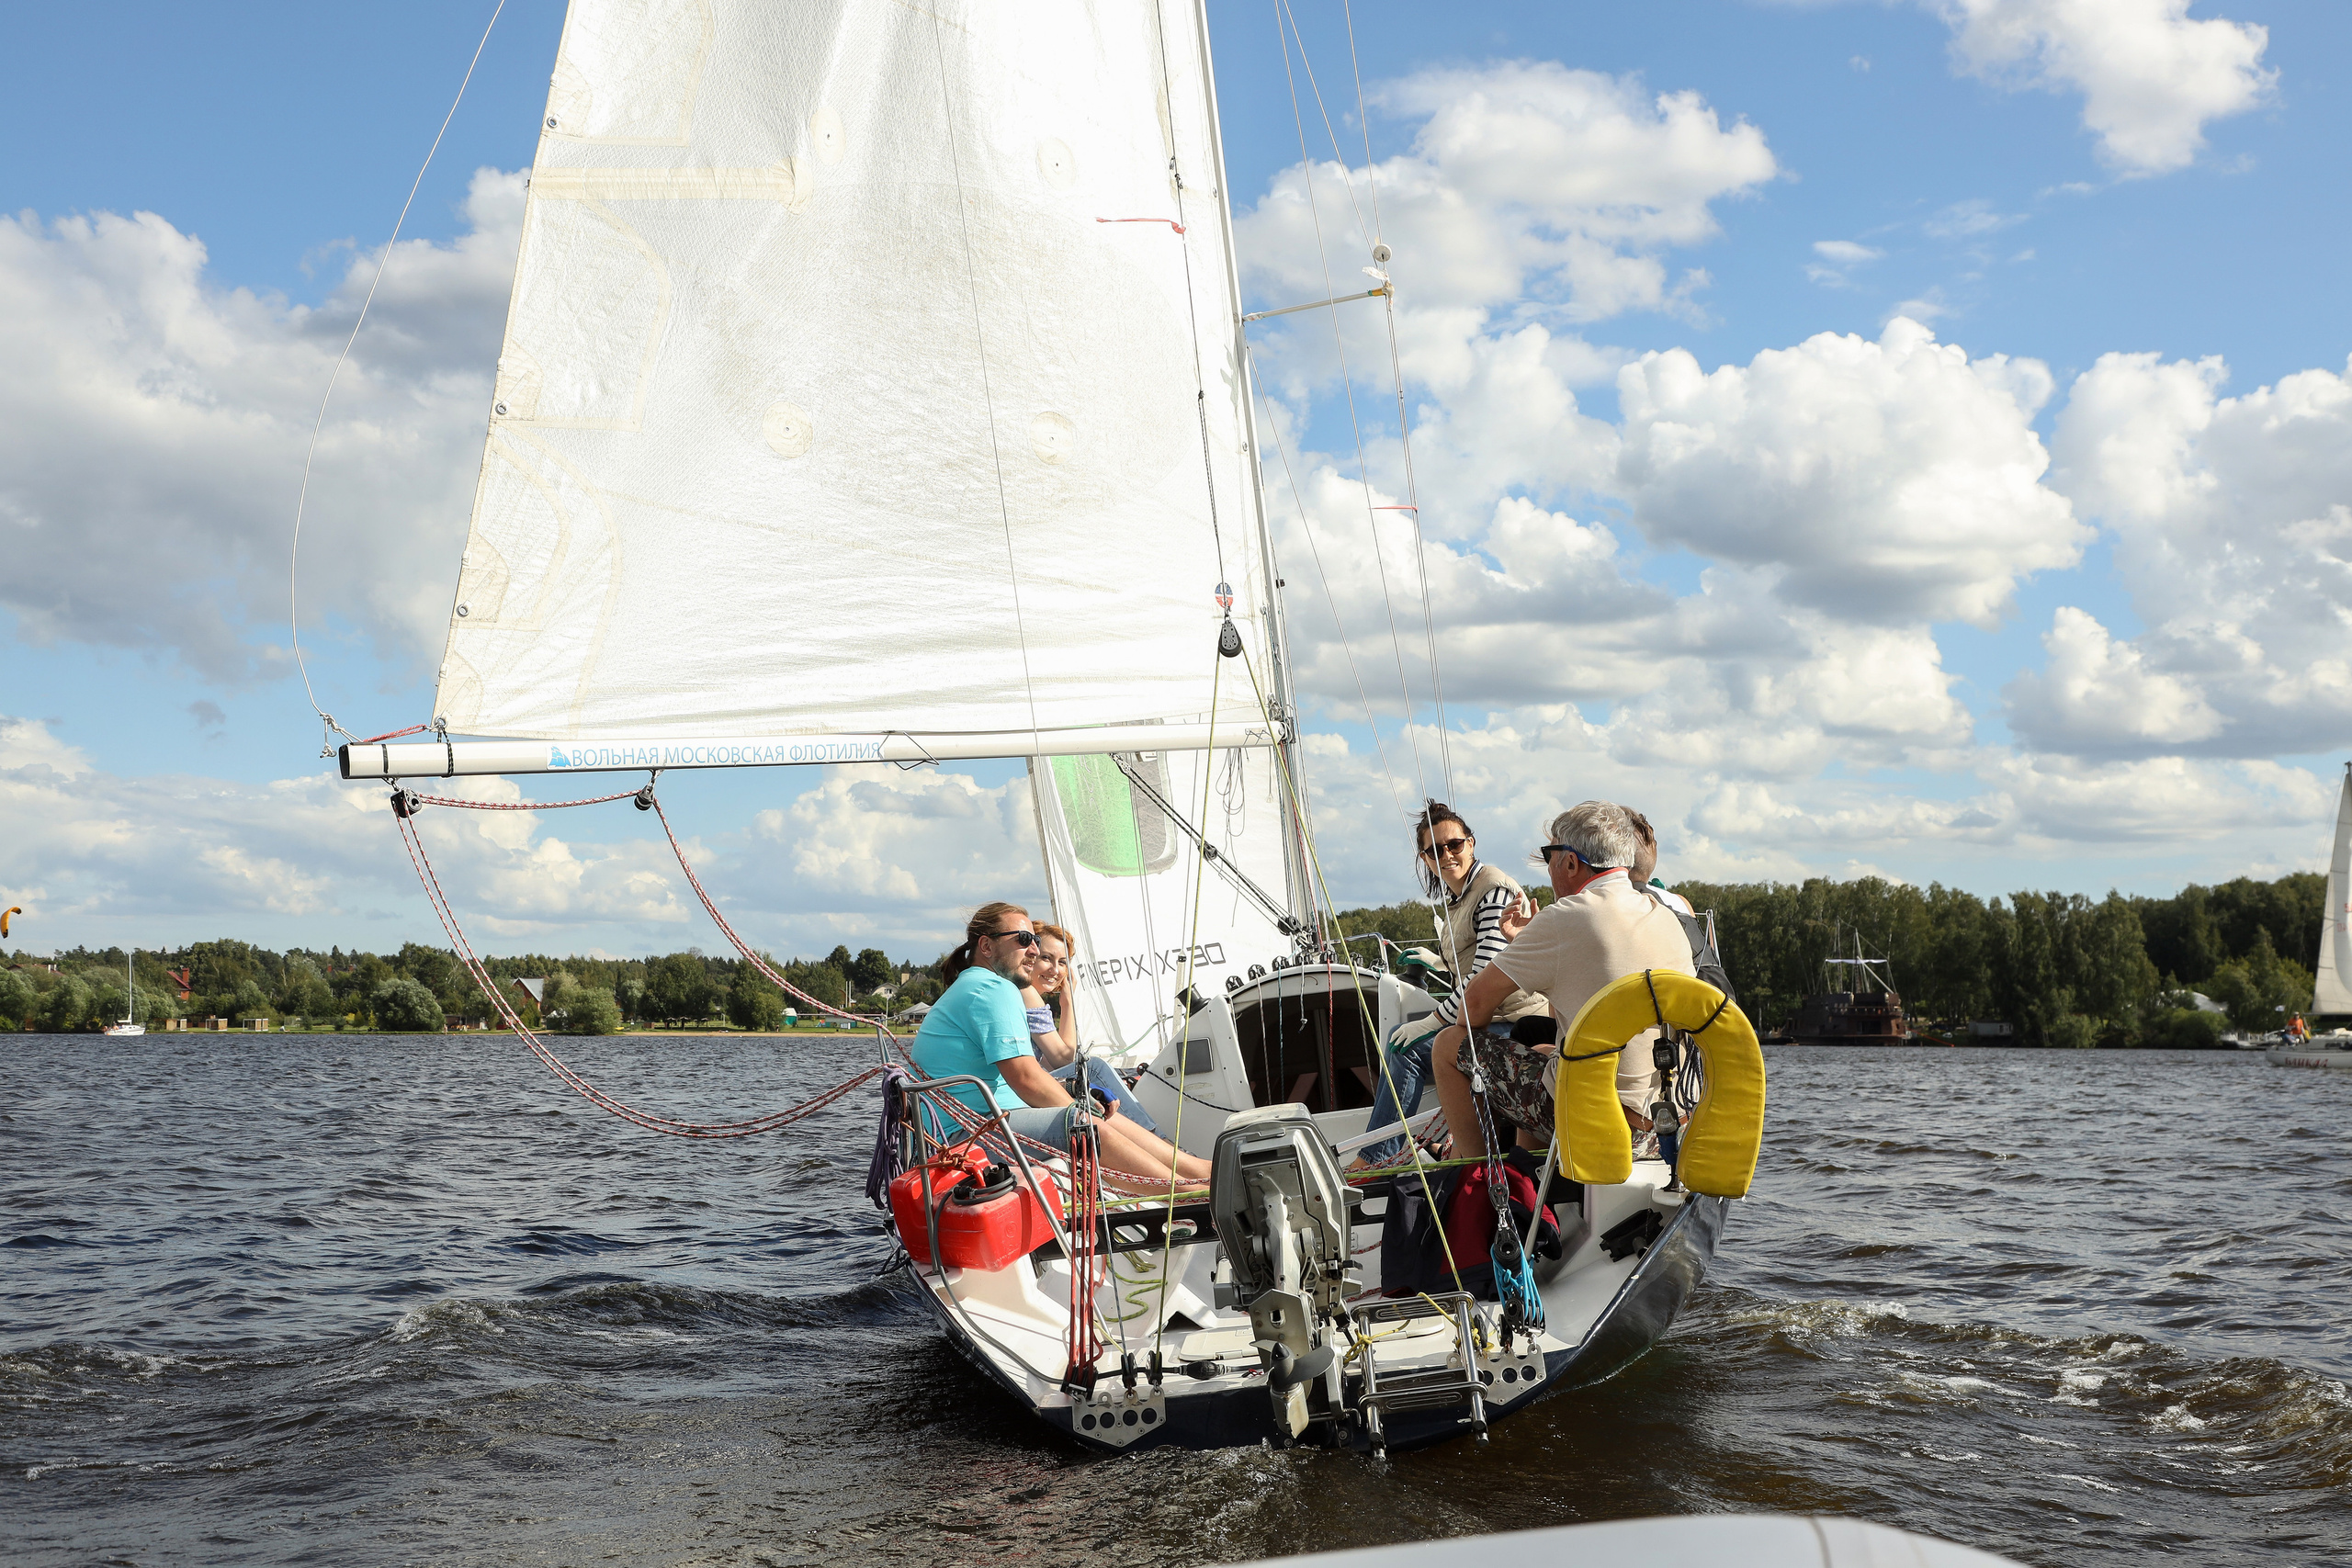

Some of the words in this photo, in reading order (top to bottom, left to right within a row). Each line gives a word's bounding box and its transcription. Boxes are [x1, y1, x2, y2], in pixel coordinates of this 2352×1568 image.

[571, 747, 659, 767] ВОЛЬНАЯ
[665, 745, 785, 764] МОСКОВСКАЯ
[789, 741, 880, 761] ФЛОТИЛИЯ
[1077, 953, 1153, 991] FINEPIX
